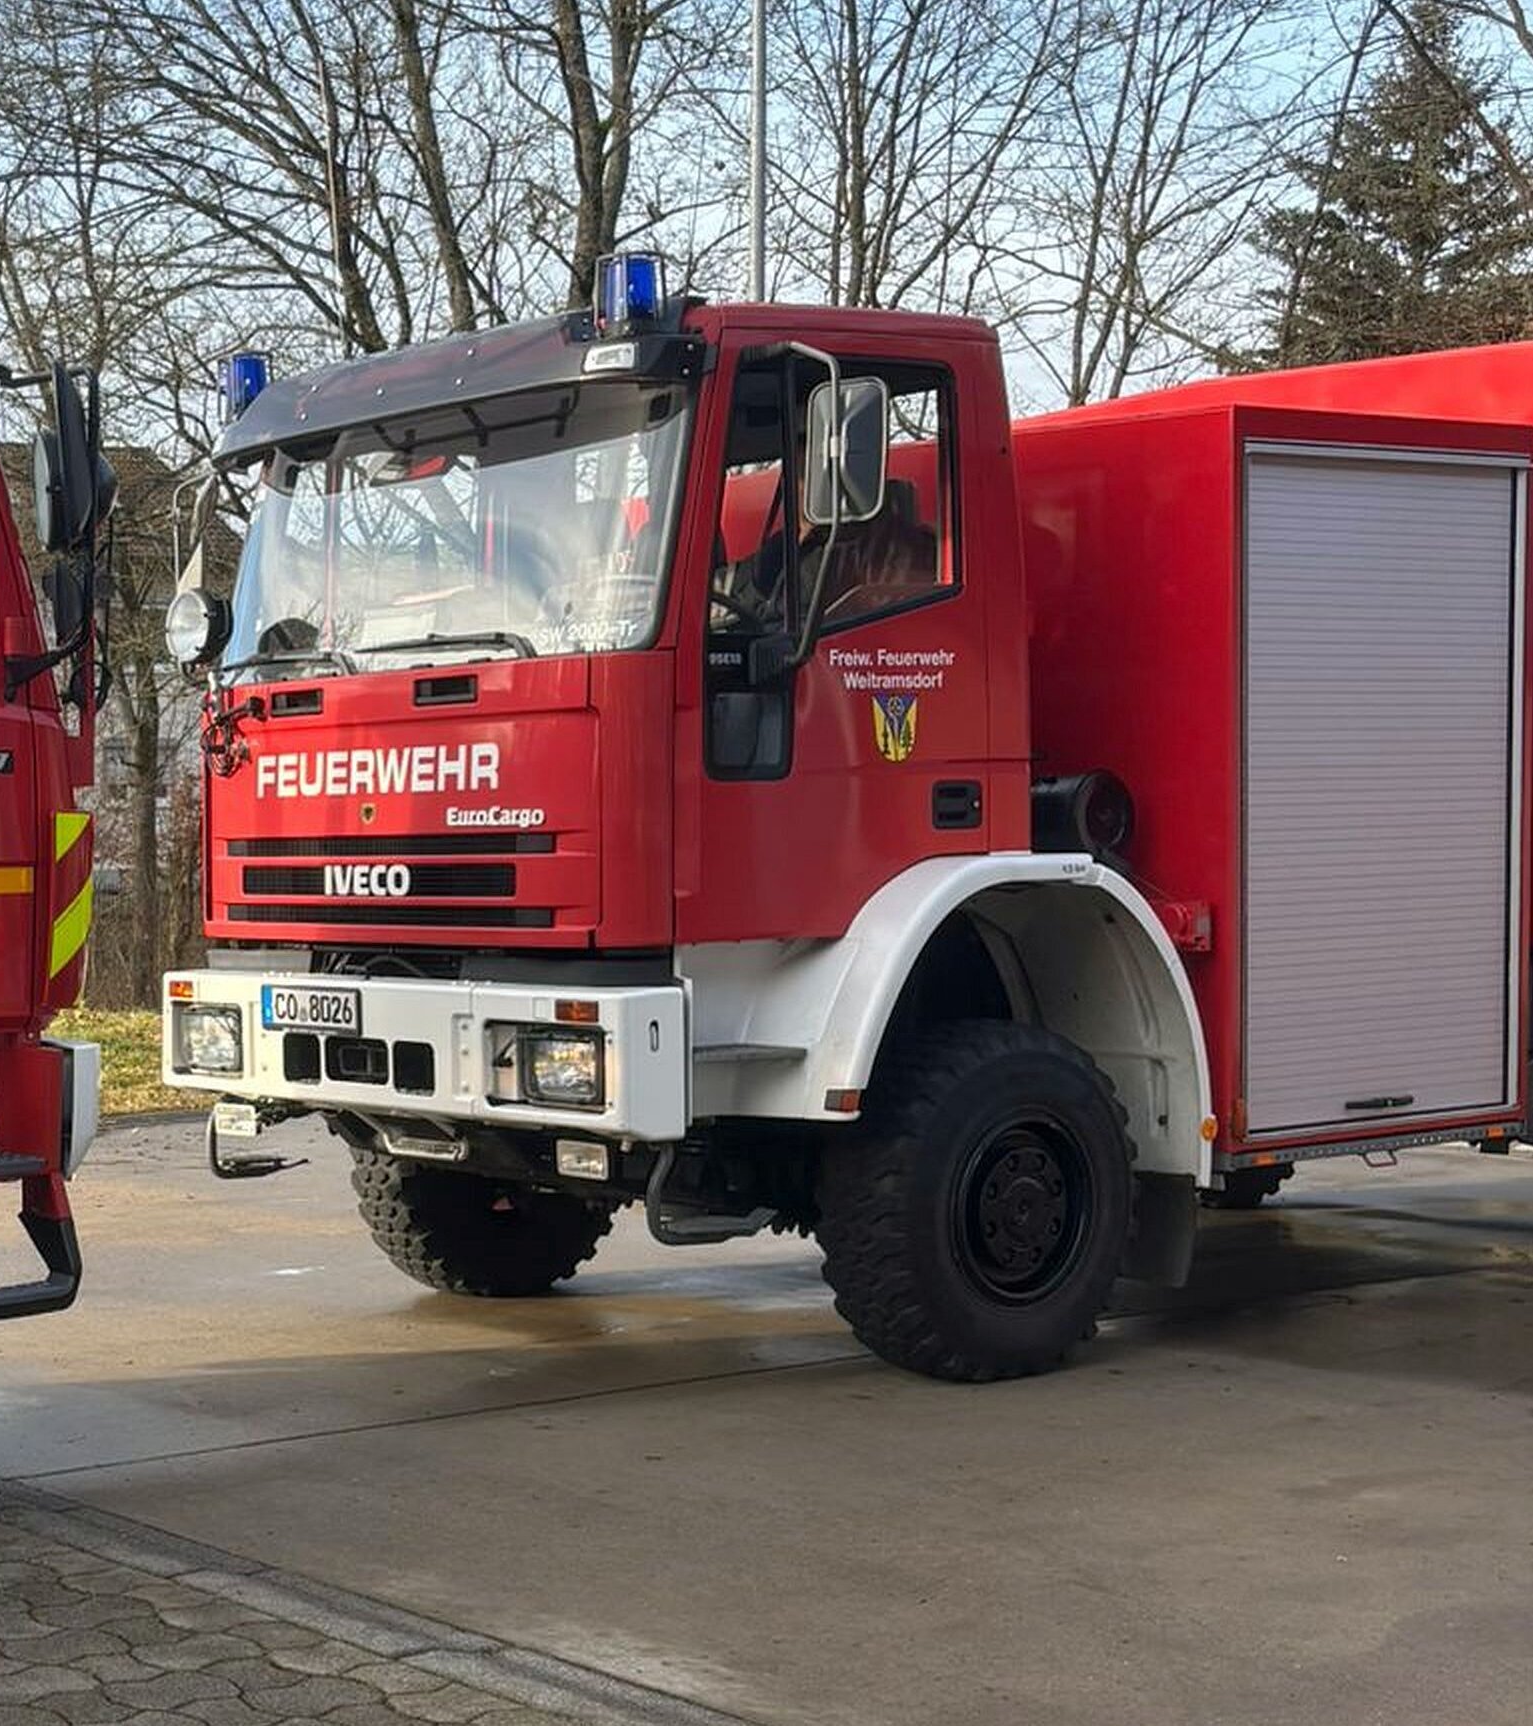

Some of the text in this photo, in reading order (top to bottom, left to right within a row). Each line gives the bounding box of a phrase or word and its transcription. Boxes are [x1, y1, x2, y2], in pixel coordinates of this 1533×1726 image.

[829, 649, 955, 666] Freiw. Feuerwehr
[843, 670, 943, 689] Weitramsdorf
[256, 742, 501, 798] FEUERWEHR
[445, 805, 545, 828] EuroCargo
[323, 864, 411, 897] IVECO
[275, 993, 353, 1024] CO 8026
